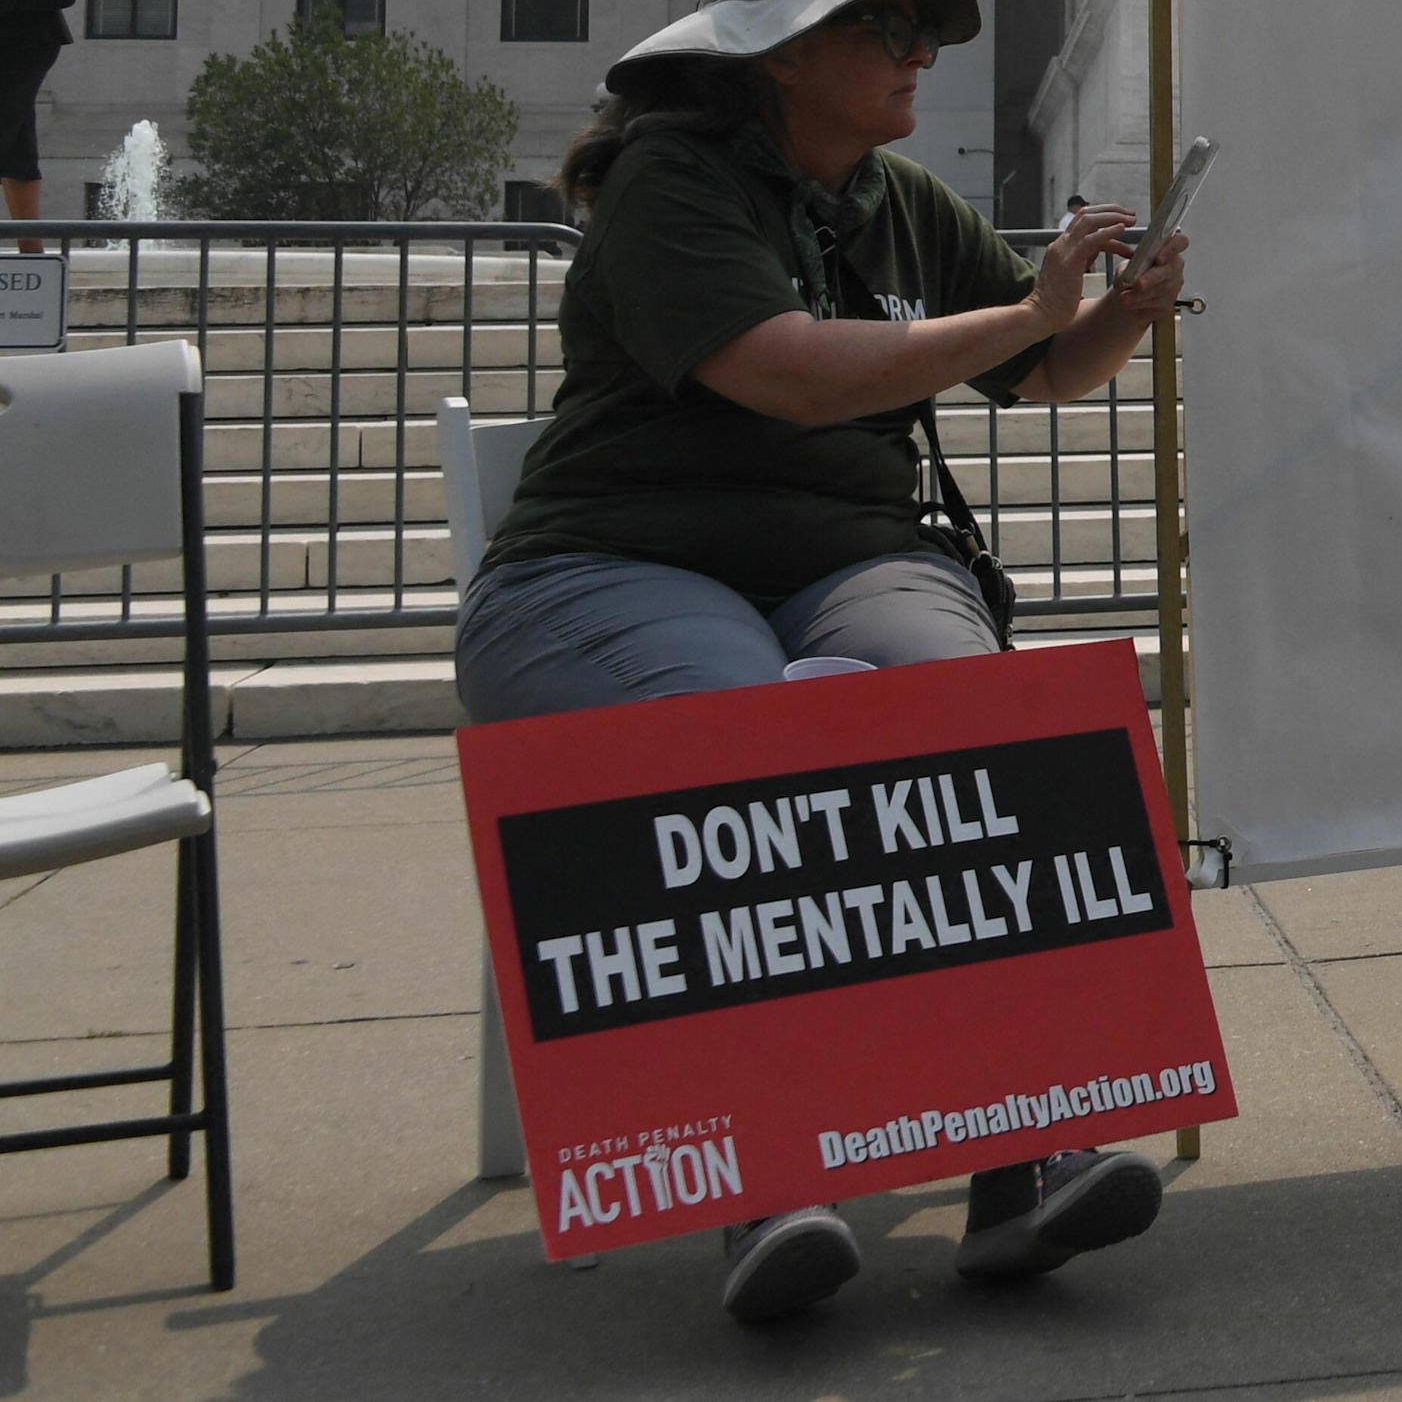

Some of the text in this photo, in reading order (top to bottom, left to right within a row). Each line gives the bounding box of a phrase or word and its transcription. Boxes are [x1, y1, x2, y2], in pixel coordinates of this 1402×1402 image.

[652, 767, 1020, 890] DON'T KILL
[537, 844, 1154, 1015] THE MENTALLY ILL
[557, 1113, 733, 1164] DEATH PENALTY
[817, 1058, 1217, 1171] DeathPenaltyAction.org
[558, 1135, 744, 1234] ACTION
